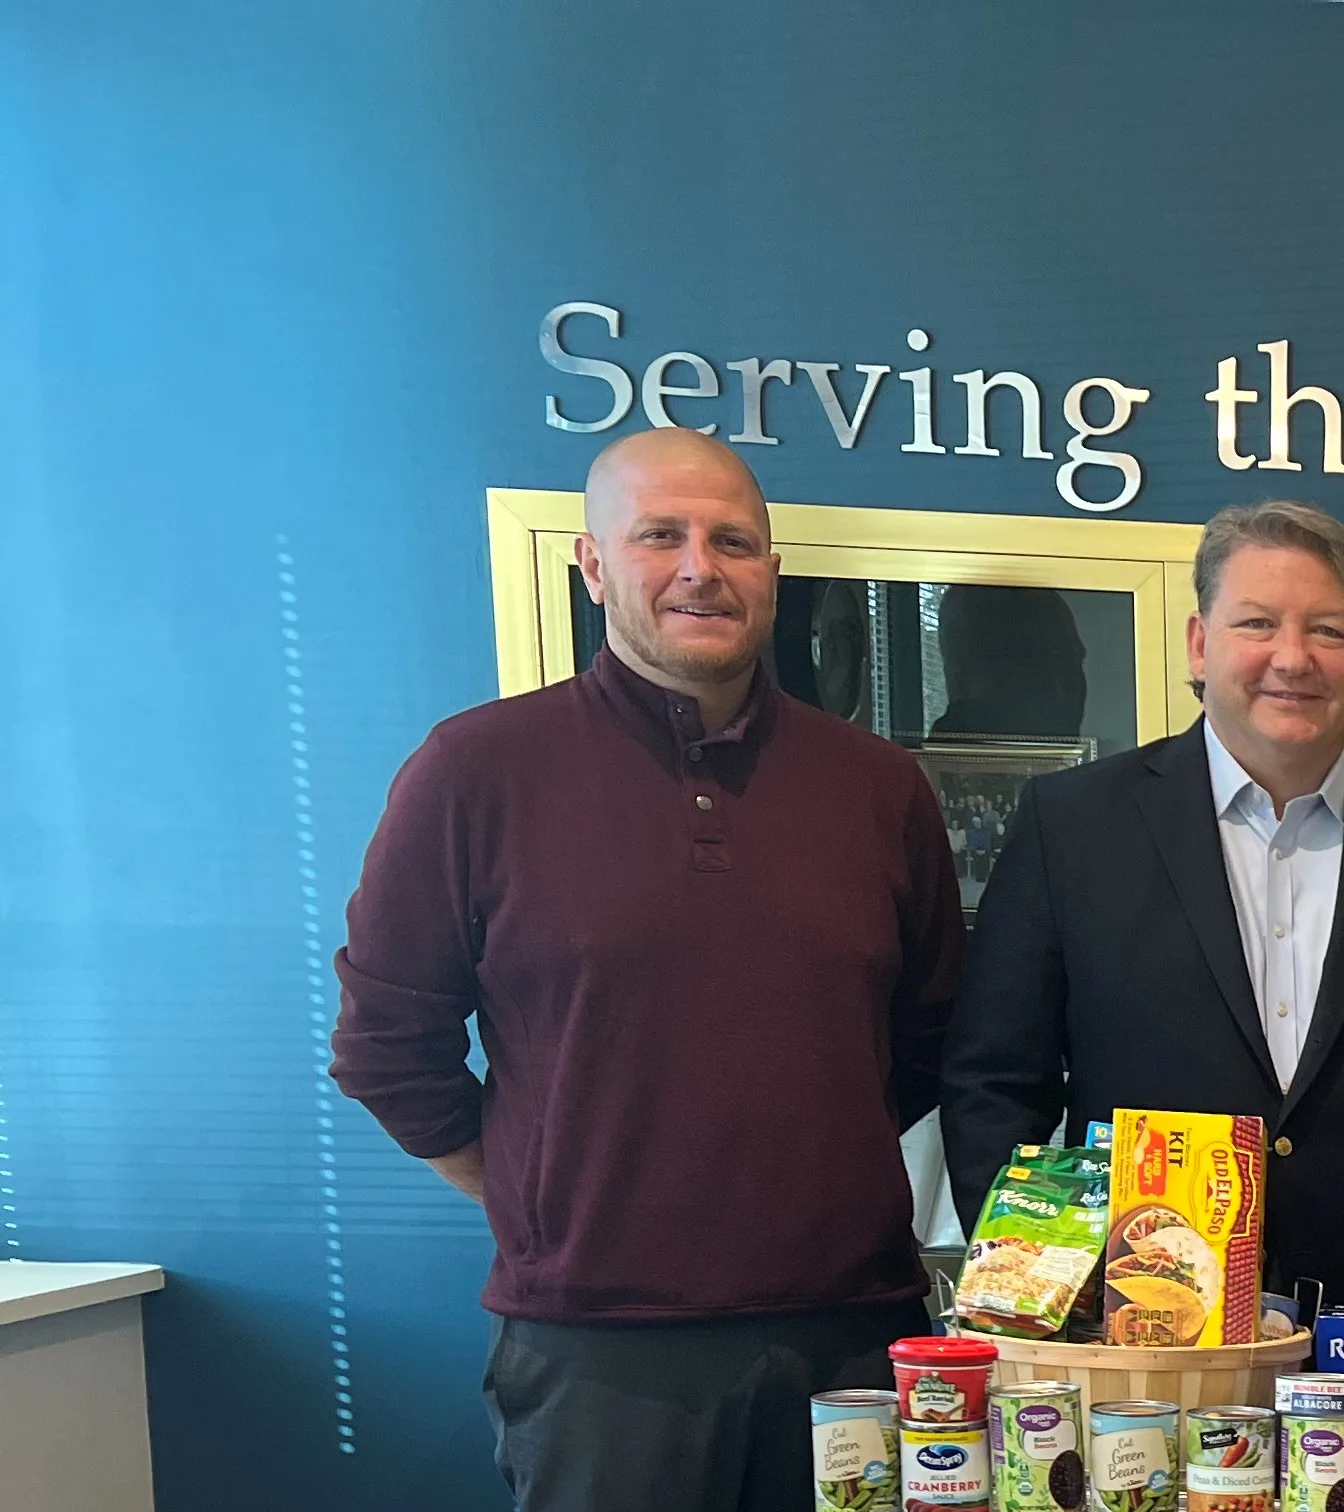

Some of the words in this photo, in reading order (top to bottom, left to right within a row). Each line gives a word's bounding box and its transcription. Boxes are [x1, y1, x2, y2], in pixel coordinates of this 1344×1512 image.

[540, 300, 1148, 511] Serving
[1167, 1130, 1185, 1169] KIT
[1210, 1149, 1230, 1179] OLD
[1214, 1178, 1232, 1196] EL
[996, 1188, 1060, 1218] Knorr
[1293, 1398, 1343, 1411] ALBACORE
[1019, 1411, 1058, 1424] Organic
[826, 1438, 861, 1456] Green
[823, 1454, 861, 1472] Beans
[1111, 1448, 1146, 1465] Green
[1108, 1463, 1146, 1481] Beans
[908, 1479, 983, 1492] CRANBERRY
